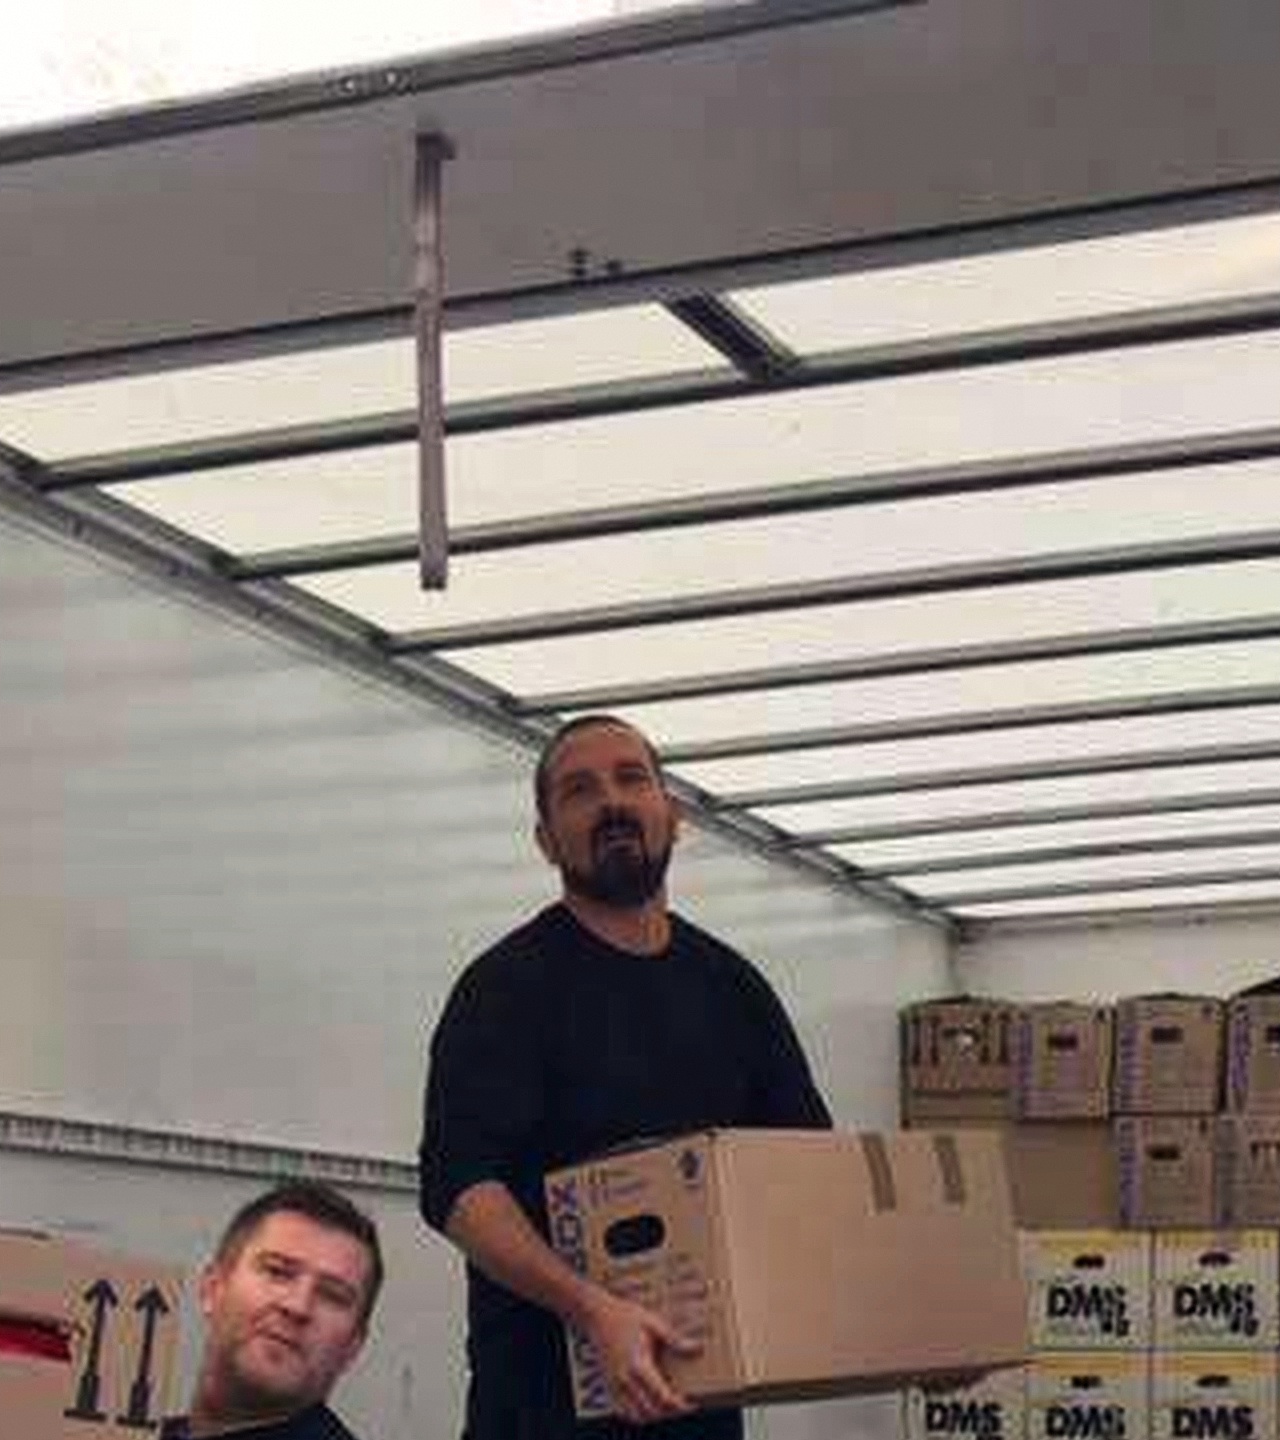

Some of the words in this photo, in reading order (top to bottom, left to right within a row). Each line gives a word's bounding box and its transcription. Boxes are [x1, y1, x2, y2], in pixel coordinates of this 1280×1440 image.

[1047, 1285, 1127, 1318] DMS
[1174, 1284, 1256, 1318] DMS
[925, 1401, 1001, 1432] DMS
[1045, 1400, 1126, 1439] DMS
[1172, 1405, 1252, 1439] DMS
